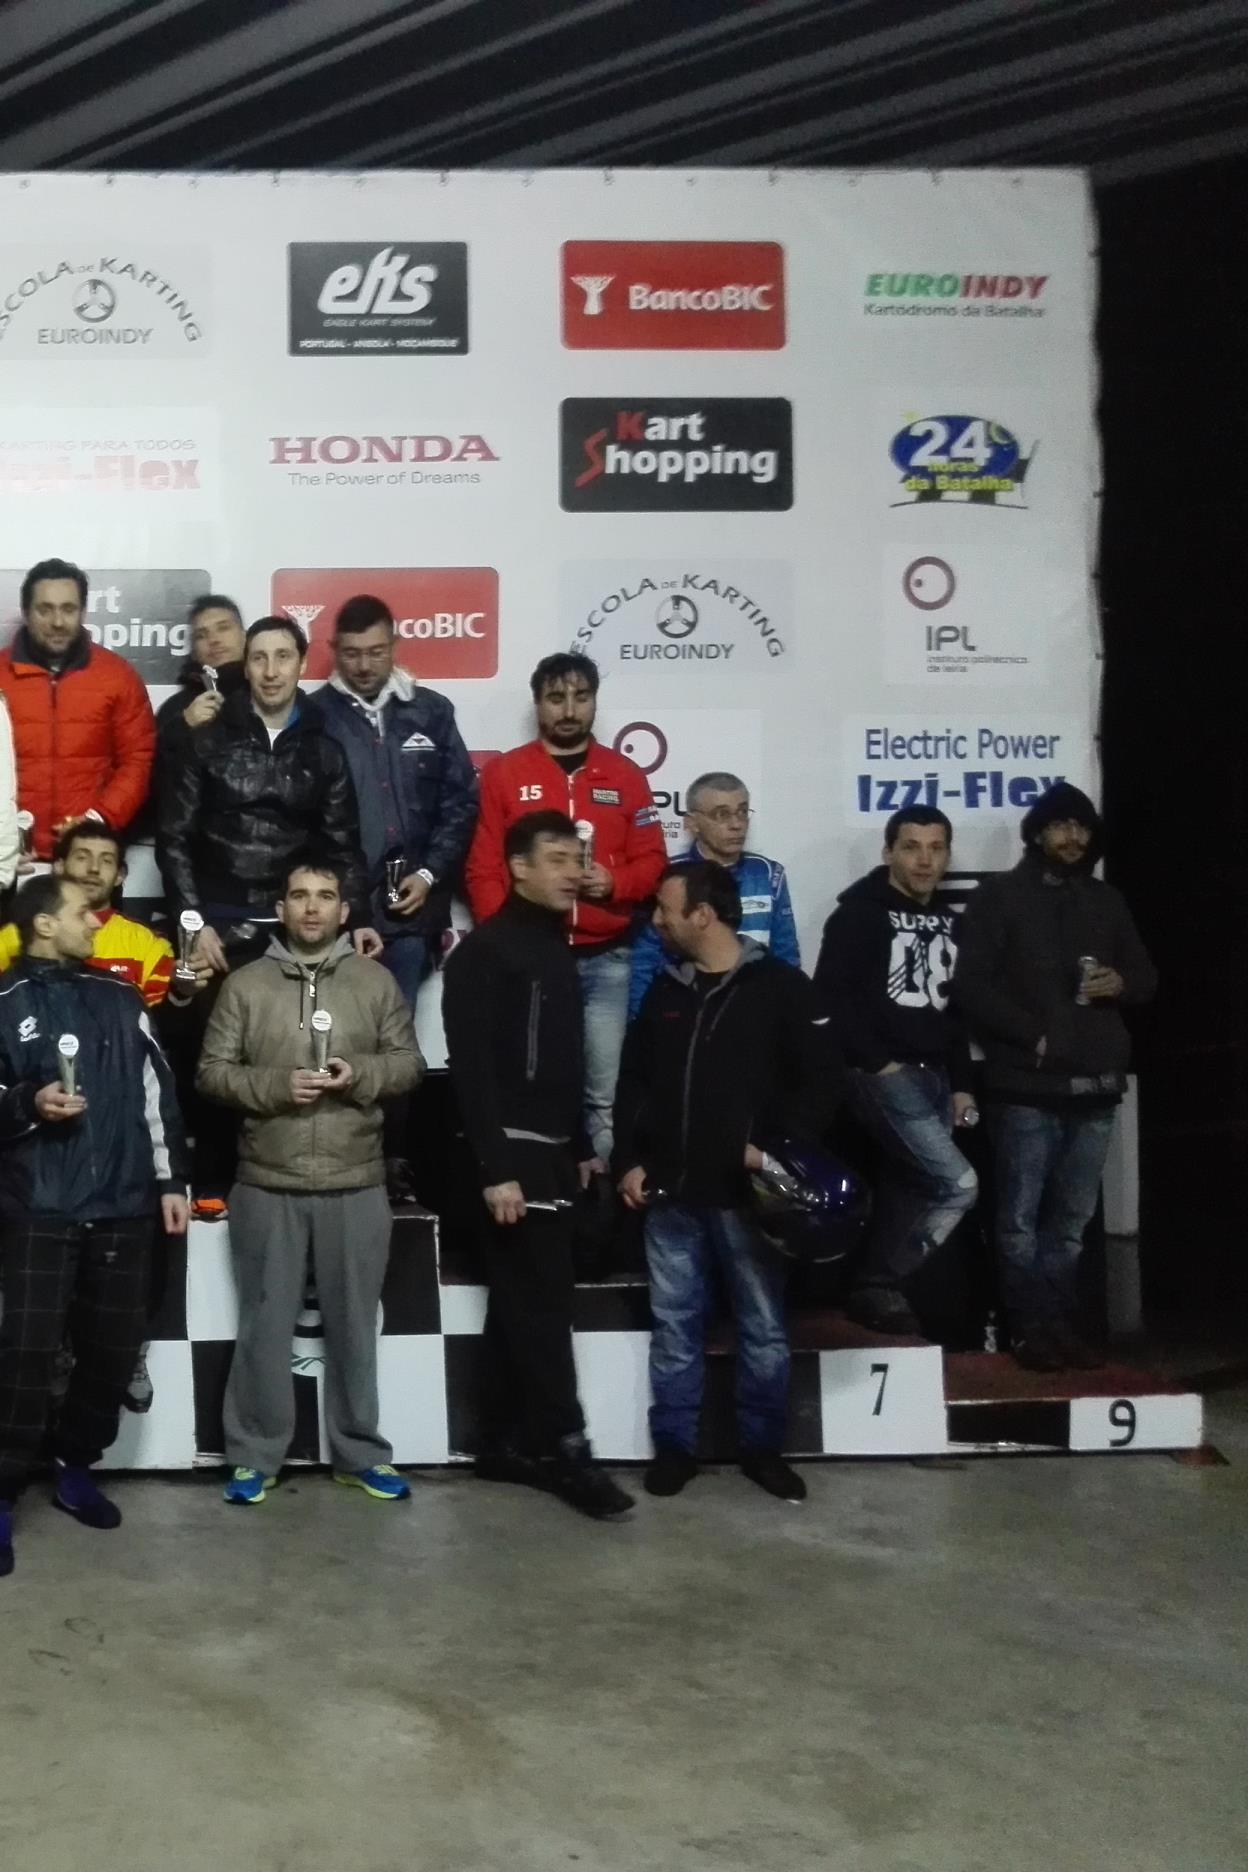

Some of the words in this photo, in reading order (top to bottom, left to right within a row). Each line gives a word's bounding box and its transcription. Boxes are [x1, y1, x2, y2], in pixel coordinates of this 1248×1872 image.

[100, 257, 202, 342] KARTING
[629, 283, 775, 312] BancoBIC
[864, 273, 1049, 299] EUROINDY
[961, 305, 980, 317] da
[985, 305, 1046, 319] Batalha
[37, 328, 153, 345] EUROINDY
[299, 338, 346, 349] PORTUGAL
[616, 411, 706, 441] Kart
[80, 439, 129, 451] PARA
[133, 439, 197, 451] TODOS
[269, 435, 500, 465] HONDA
[575, 429, 778, 484] Shopping
[909, 420, 992, 467] 24
[288, 471, 321, 486] The
[325, 472, 383, 486] Power
[386, 470, 405, 486] of
[410, 470, 482, 486] Dreams
[905, 476, 930, 491] da
[935, 475, 1014, 491] Batalha
[86, 586, 121, 613] rt
[393, 612, 487, 639] coBIC
[661, 580, 678, 590] DE
[682, 574, 784, 657] KARTING
[620, 643, 735, 660] EUROINDY
[926, 625, 976, 651] IPL
[865, 727, 968, 760] Electric
[977, 728, 1061, 760] Power
[519, 785, 543, 801] 15
[870, 1363, 890, 1416] 7
[1109, 1399, 1137, 1447] 9
